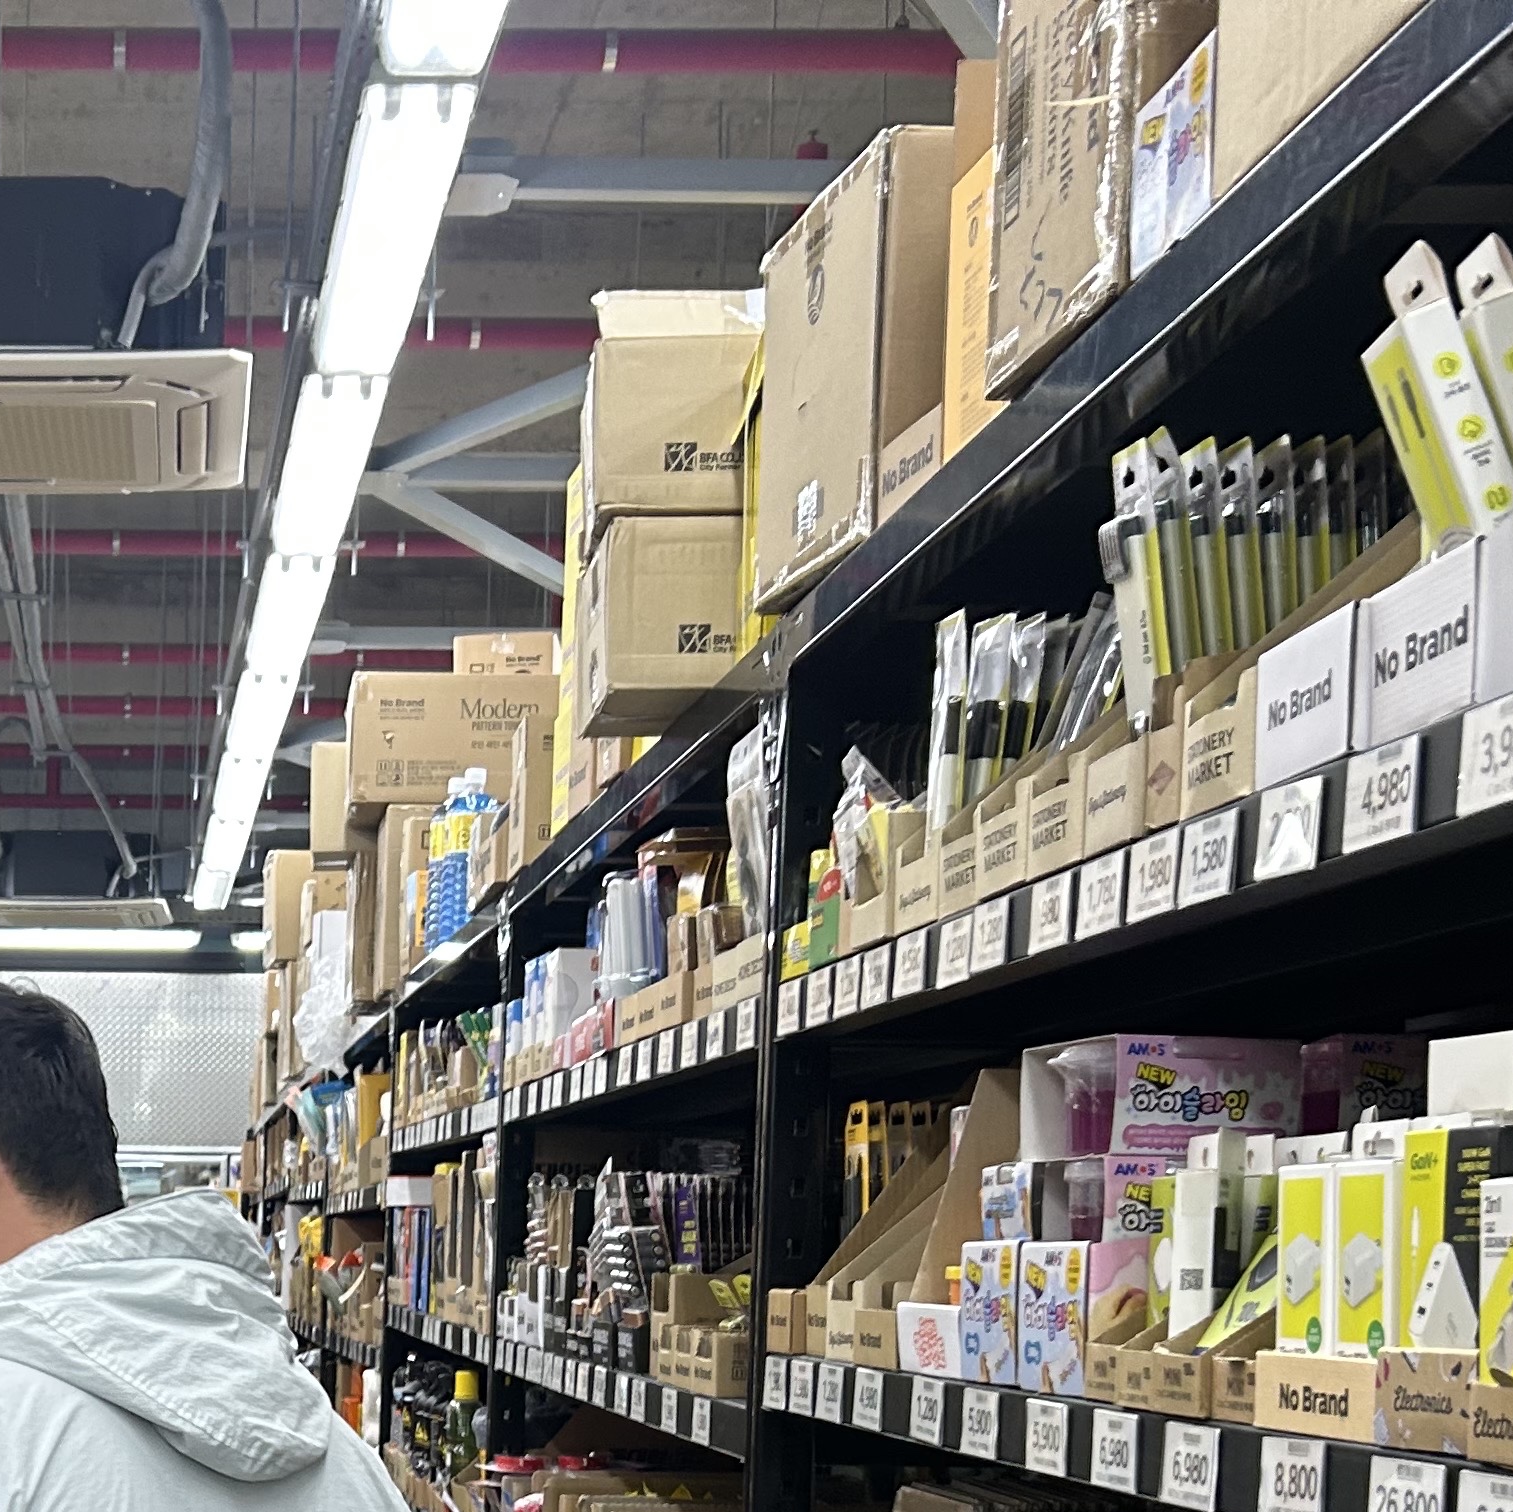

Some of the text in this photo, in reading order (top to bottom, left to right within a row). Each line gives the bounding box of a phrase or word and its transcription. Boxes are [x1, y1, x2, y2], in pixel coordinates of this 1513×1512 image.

[882, 435, 934, 498] No Brand
[1374, 605, 1469, 687] No Brand
[460, 698, 539, 720] Modern
[1267, 669, 1332, 731] No Brand
[1187, 751, 1235, 791] MARKET
[1361, 766, 1412, 814] 4,980
[1032, 819, 1068, 851] MARKET
[984, 842, 1017, 873] MARKET
[1139, 854, 1172, 893] 1,980
[1190, 837, 1226, 876] 1,580
[945, 865, 975, 893] MARKET
[1136, 1062, 1177, 1087] NEW
[1124, 1182, 1150, 1202] NE
[1279, 1382, 1349, 1418] No Brand
[1393, 1385, 1454, 1416] Electronics
[1031, 1418, 1061, 1452] 5,900
[1099, 1435, 1129, 1470] 6,980
[1172, 1451, 1207, 1487] 6,980
[1274, 1462, 1318, 1503] 8,800
